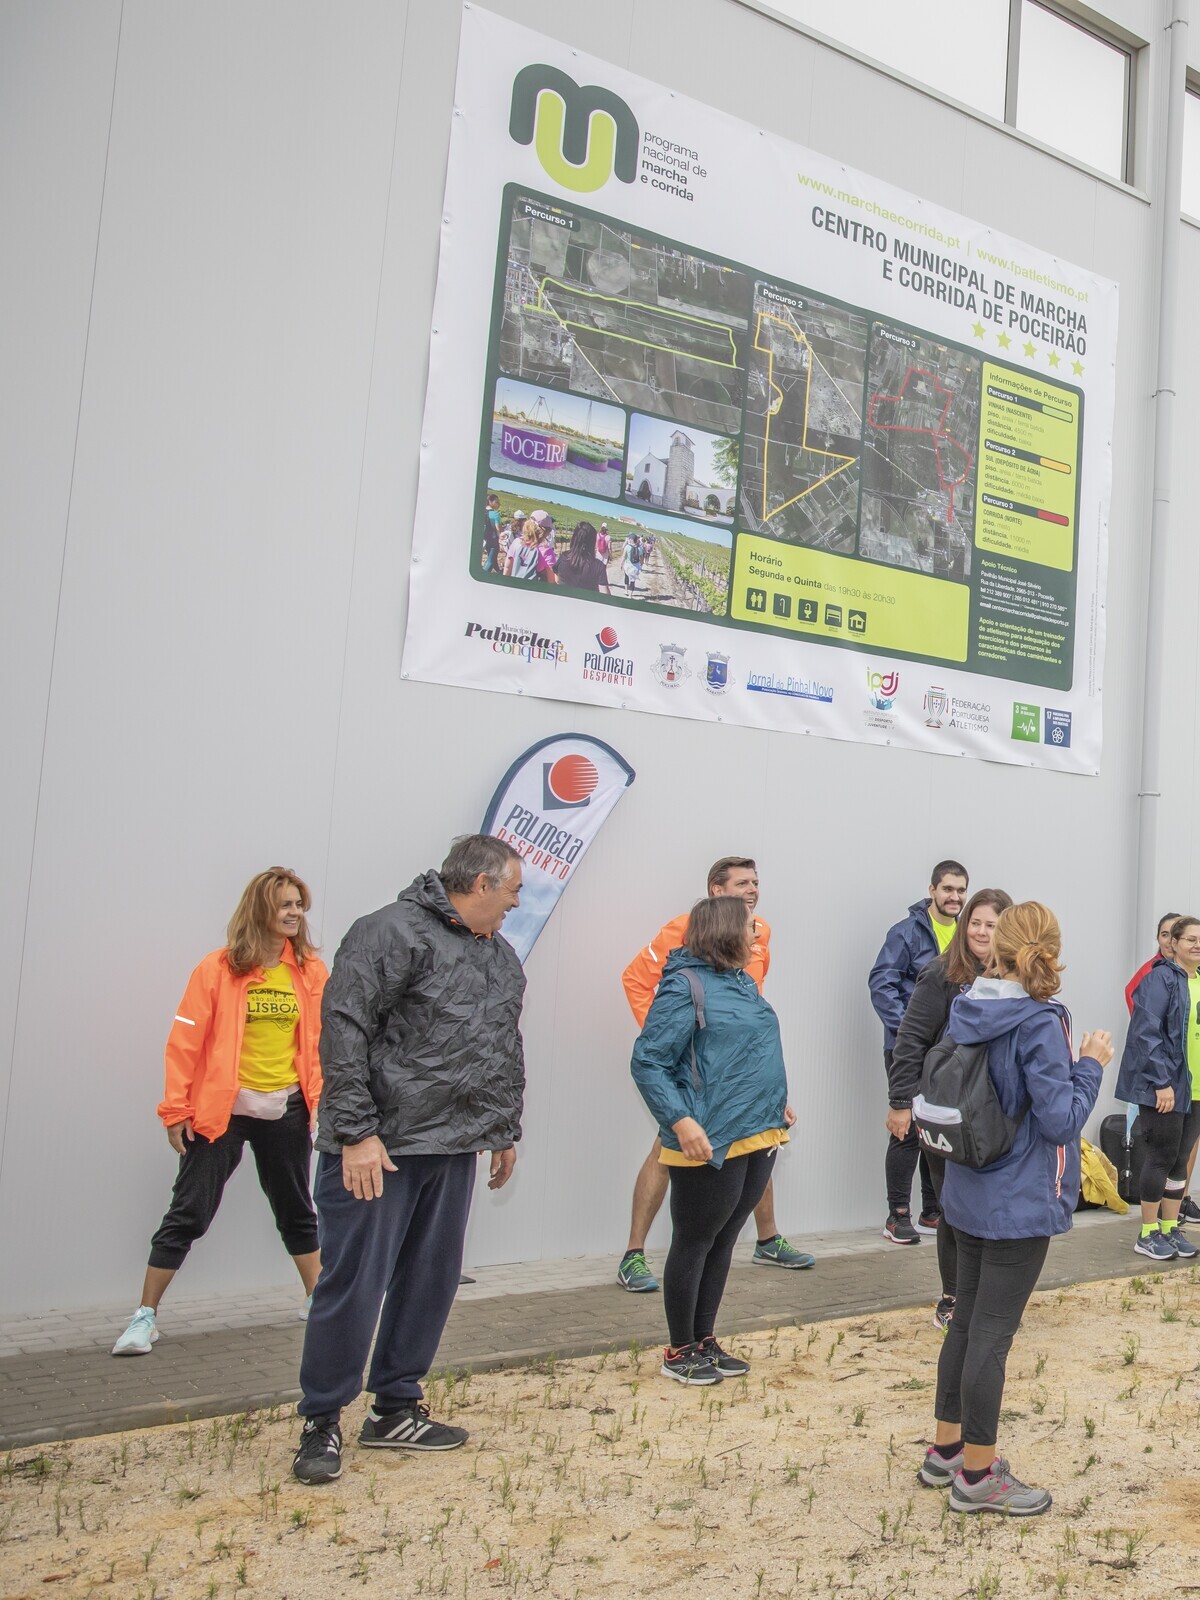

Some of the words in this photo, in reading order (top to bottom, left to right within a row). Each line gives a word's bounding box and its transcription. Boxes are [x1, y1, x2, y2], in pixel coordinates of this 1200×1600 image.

[644, 131, 699, 161] programa
[643, 144, 690, 171] nacional
[692, 163, 707, 178] de
[642, 159, 688, 185] marcha
[641, 173, 648, 183] e
[651, 176, 694, 201] corrida
[525, 205, 565, 226] Percurso
[569, 220, 573, 228] 1
[797, 173, 960, 249] www.marchaecorrida.pt
[977, 248, 1089, 303] www.fpatletismo.pt
[811, 205, 887, 253] CENTRO
[893, 238, 988, 294] MUNICIPAL
[994, 280, 1015, 305] DE
[1020, 290, 1087, 334] MARCHA
[763, 288, 796, 306] Percurso
[882, 259, 893, 281] E
[899, 266, 977, 314] CORRIDA
[983, 300, 1002, 324] DE
[1009, 310, 1086, 356] POCEIRÃO
[880, 330, 909, 347] Percurso
[911, 340, 916, 348] 3
[989, 387, 1013, 401] Percurso
[990, 372, 1032, 395] Informações
[1044, 392, 1072, 408] Percurso
[986, 441, 1011, 454] Percurso
[984, 495, 1008, 508] Percurso
[749, 551, 783, 567] Horário
[981, 559, 996, 569] Apoio
[997, 564, 1017, 574] Técnico
[748, 565, 785, 583] Segunda
[794, 575, 822, 589] Quinta
[824, 582, 837, 593] das
[838, 585, 861, 598] 19h30
[873, 593, 896, 606] 20h30
[464, 621, 551, 649] Palmela
[979, 617, 994, 626] Apoio
[999, 621, 1026, 634] orientação
[1043, 632, 1065, 641] treinador
[987, 627, 1009, 637] atletismo
[1011, 633, 1022, 641] para
[1024, 635, 1050, 647] adequação
[492, 640, 568, 664] conquista
[978, 633, 1004, 644] exercícios
[1020, 643, 1044, 653] percursos
[978, 641, 1015, 655] características
[1027, 652, 1057, 664] caminhantes
[978, 650, 1007, 661] corredores.
[583, 669, 633, 687] DESPORTO
[747, 670, 774, 688] Jornal
[776, 680, 784, 689] do
[787, 677, 810, 693] Pinhal
[813, 682, 834, 697] Novo
[952, 698, 991, 713] FEDERAÇÃO
[952, 709, 990, 723] PORTUGUESA
[949, 719, 989, 733] ATLETISMO
[247, 1002, 299, 1013] LISBOA
